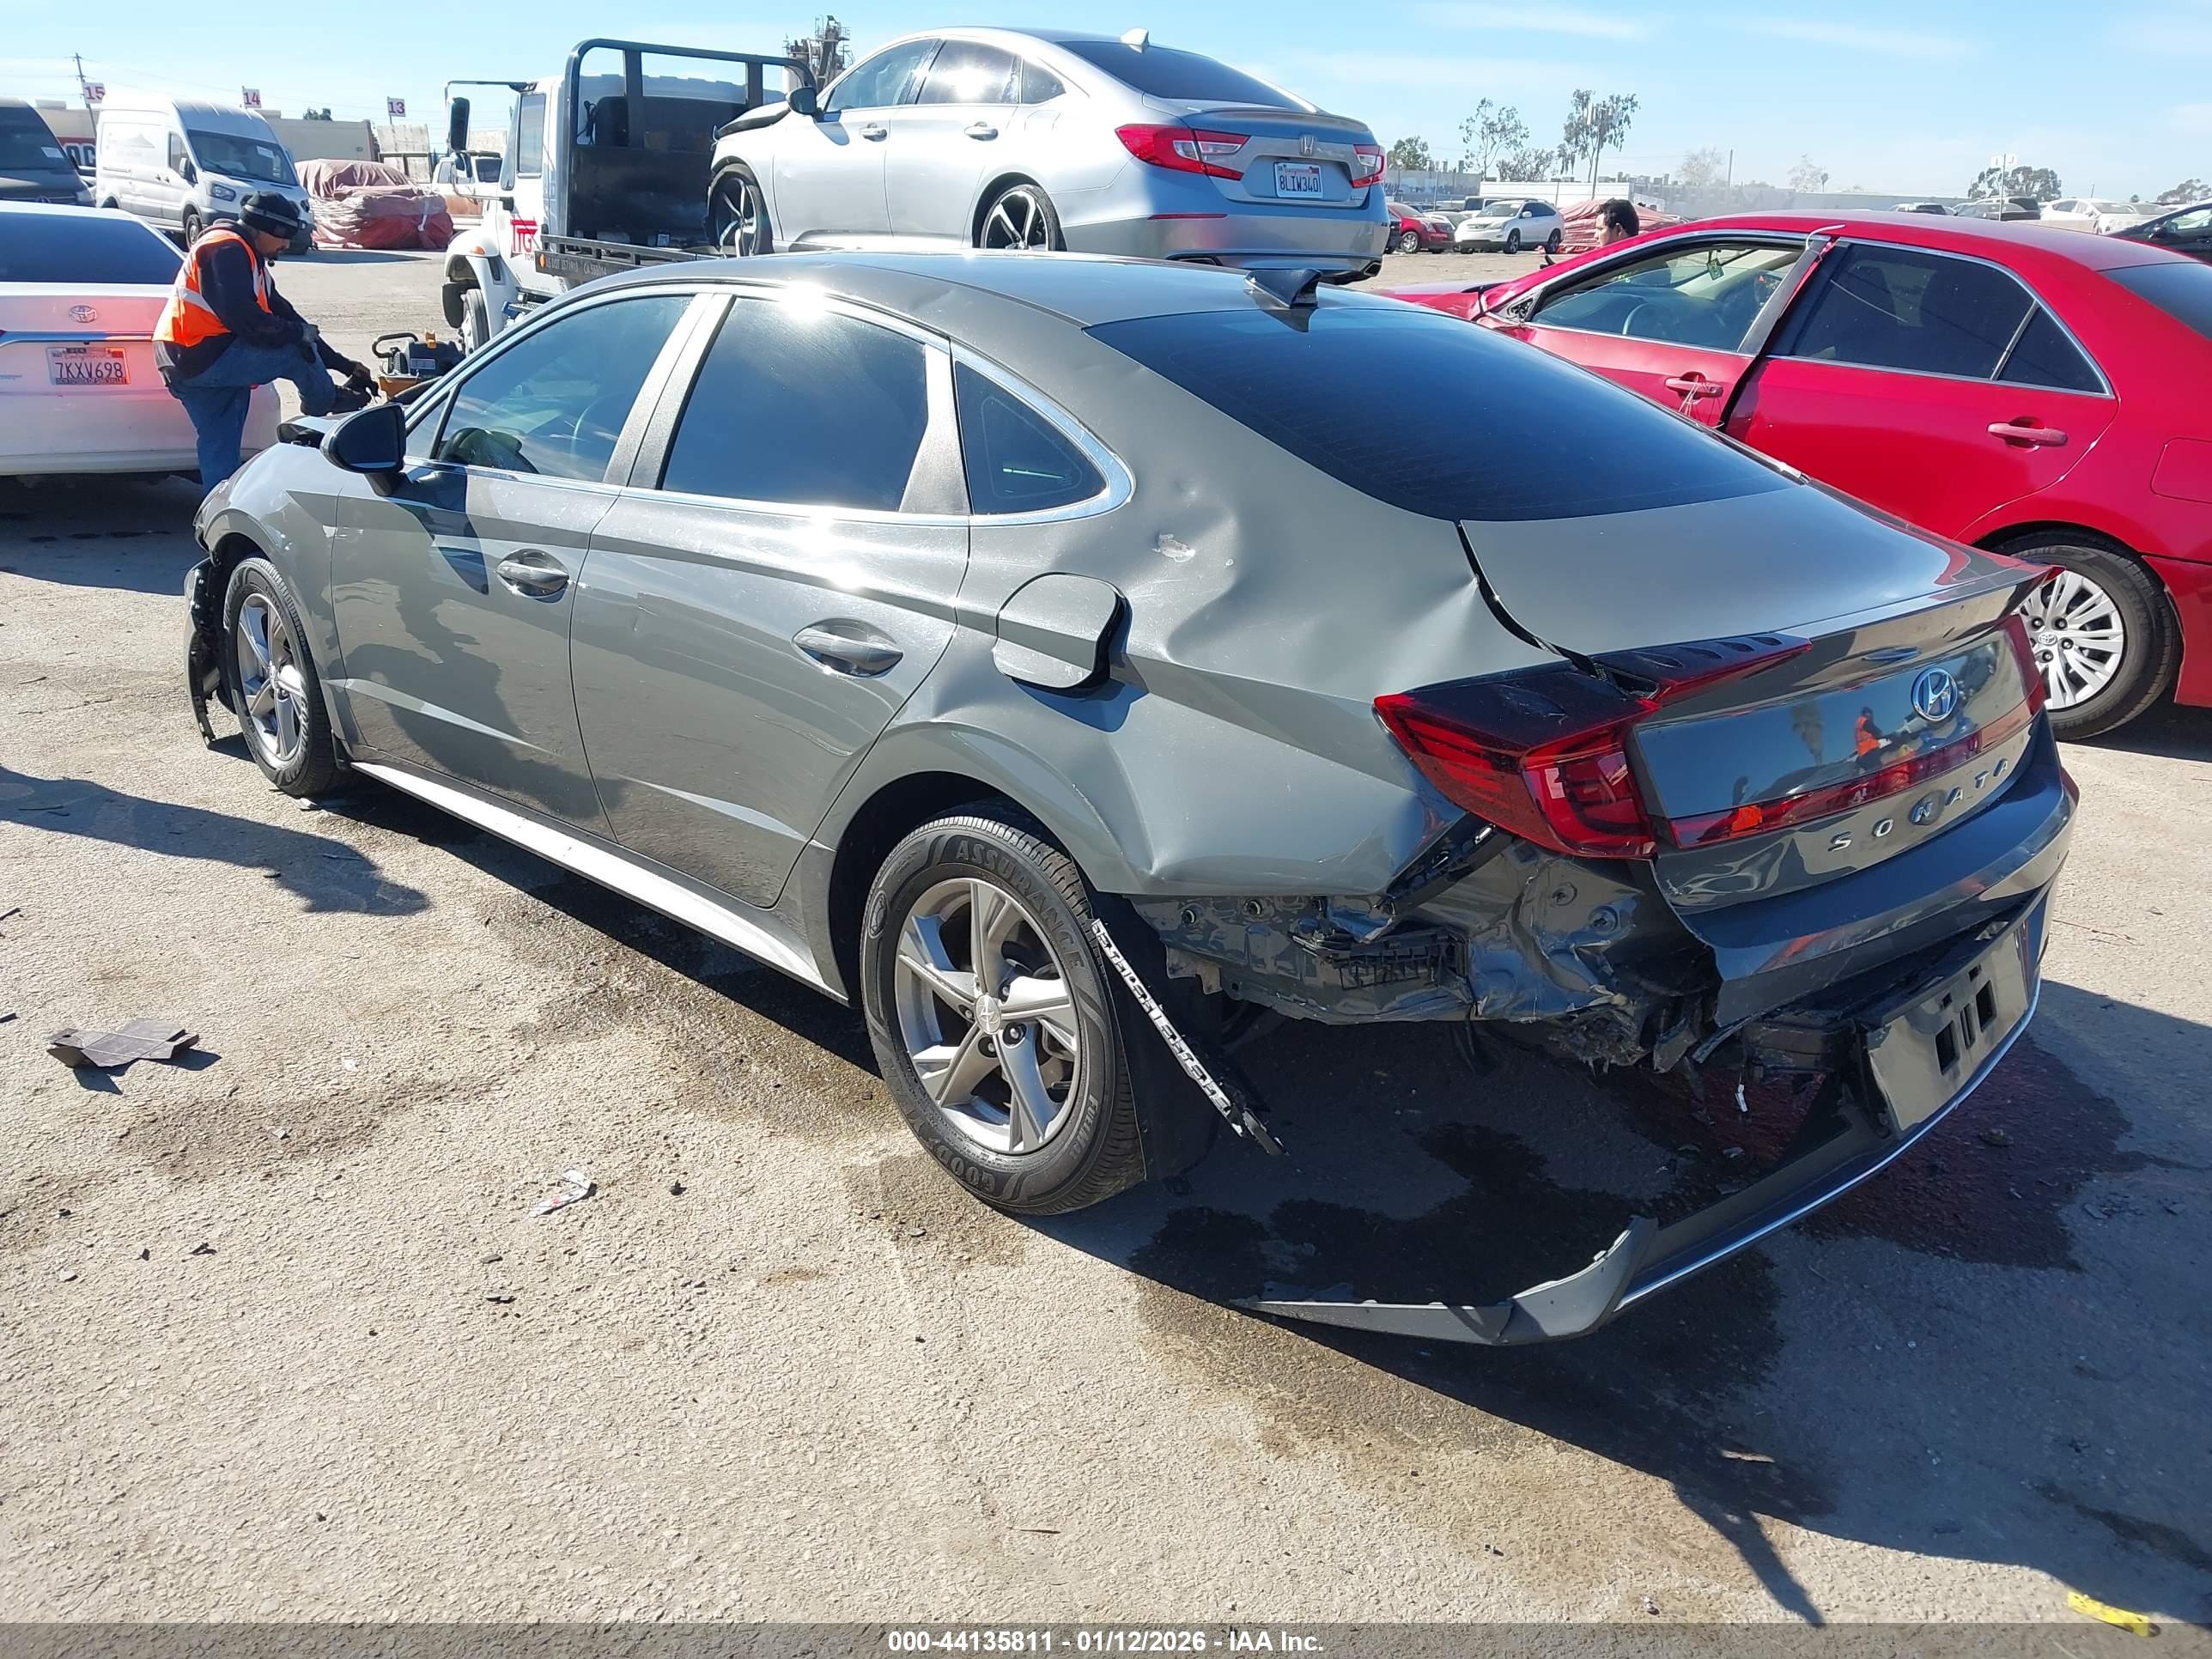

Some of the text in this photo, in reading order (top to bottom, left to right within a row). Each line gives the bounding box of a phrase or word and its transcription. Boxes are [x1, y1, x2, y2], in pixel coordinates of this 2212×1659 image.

[84, 86, 105, 100] 15
[244, 92, 261, 106] 14
[388, 101, 405, 114] 13
[1279, 174, 1320, 193] 8LIW340
[54, 362, 124, 380] 7KXV698
[1827, 758, 2008, 852] SONATA
[956, 839, 1085, 970] ASSURANCE
